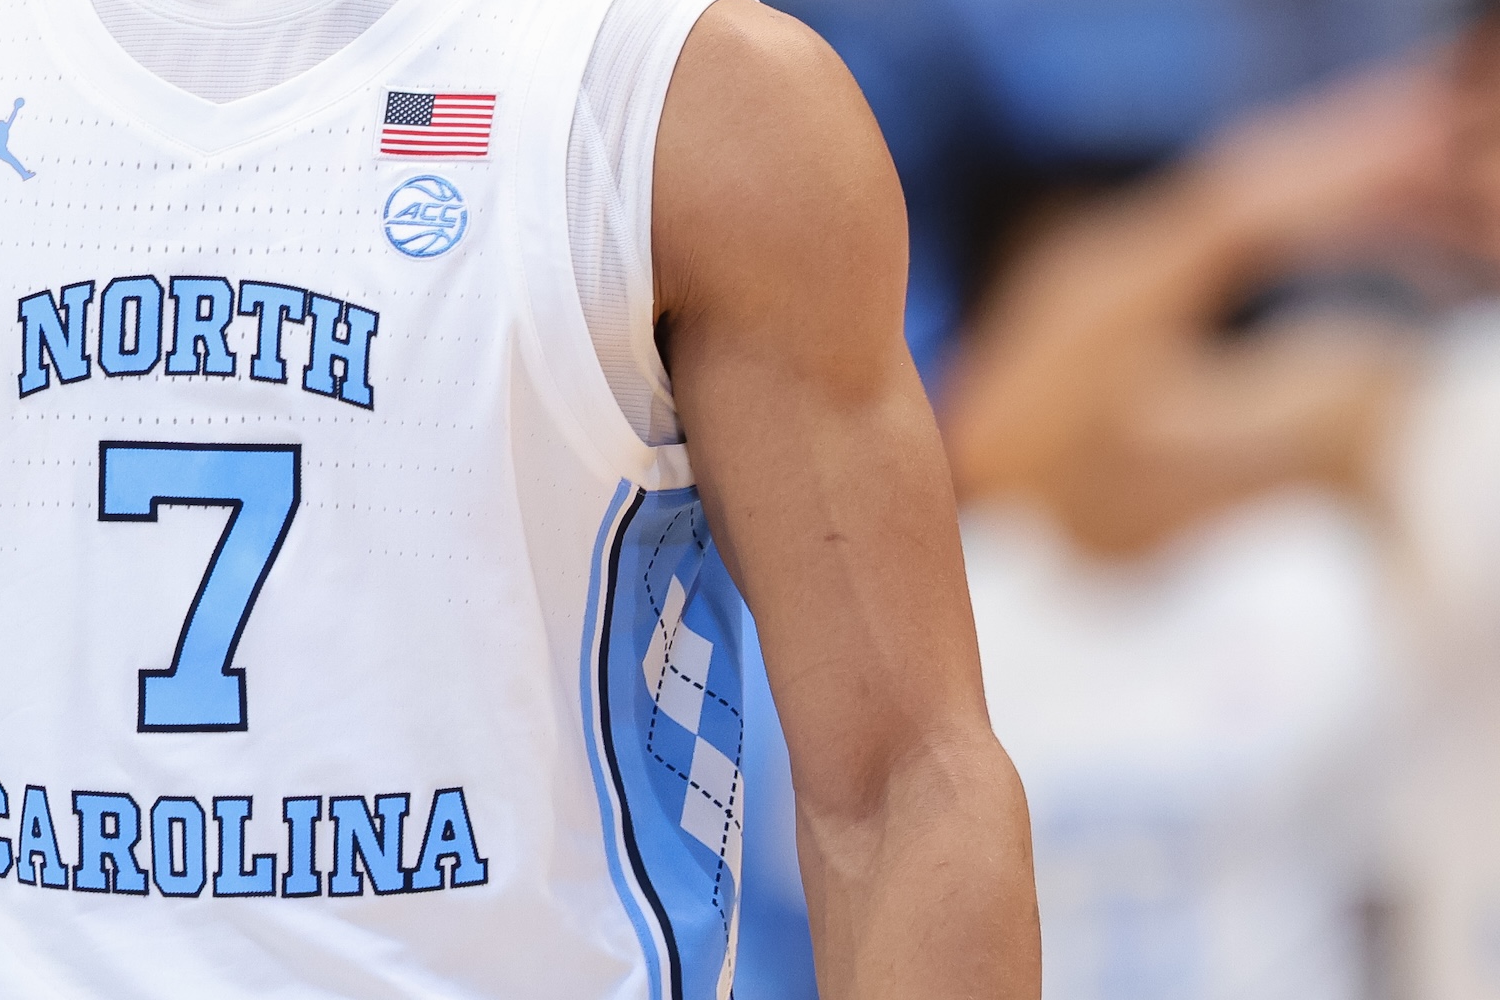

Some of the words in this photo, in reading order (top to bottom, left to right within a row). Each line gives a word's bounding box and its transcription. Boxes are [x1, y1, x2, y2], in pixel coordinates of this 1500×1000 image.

[394, 202, 463, 223] ACC
[18, 275, 380, 411] NORTH
[99, 440, 301, 732] 7
